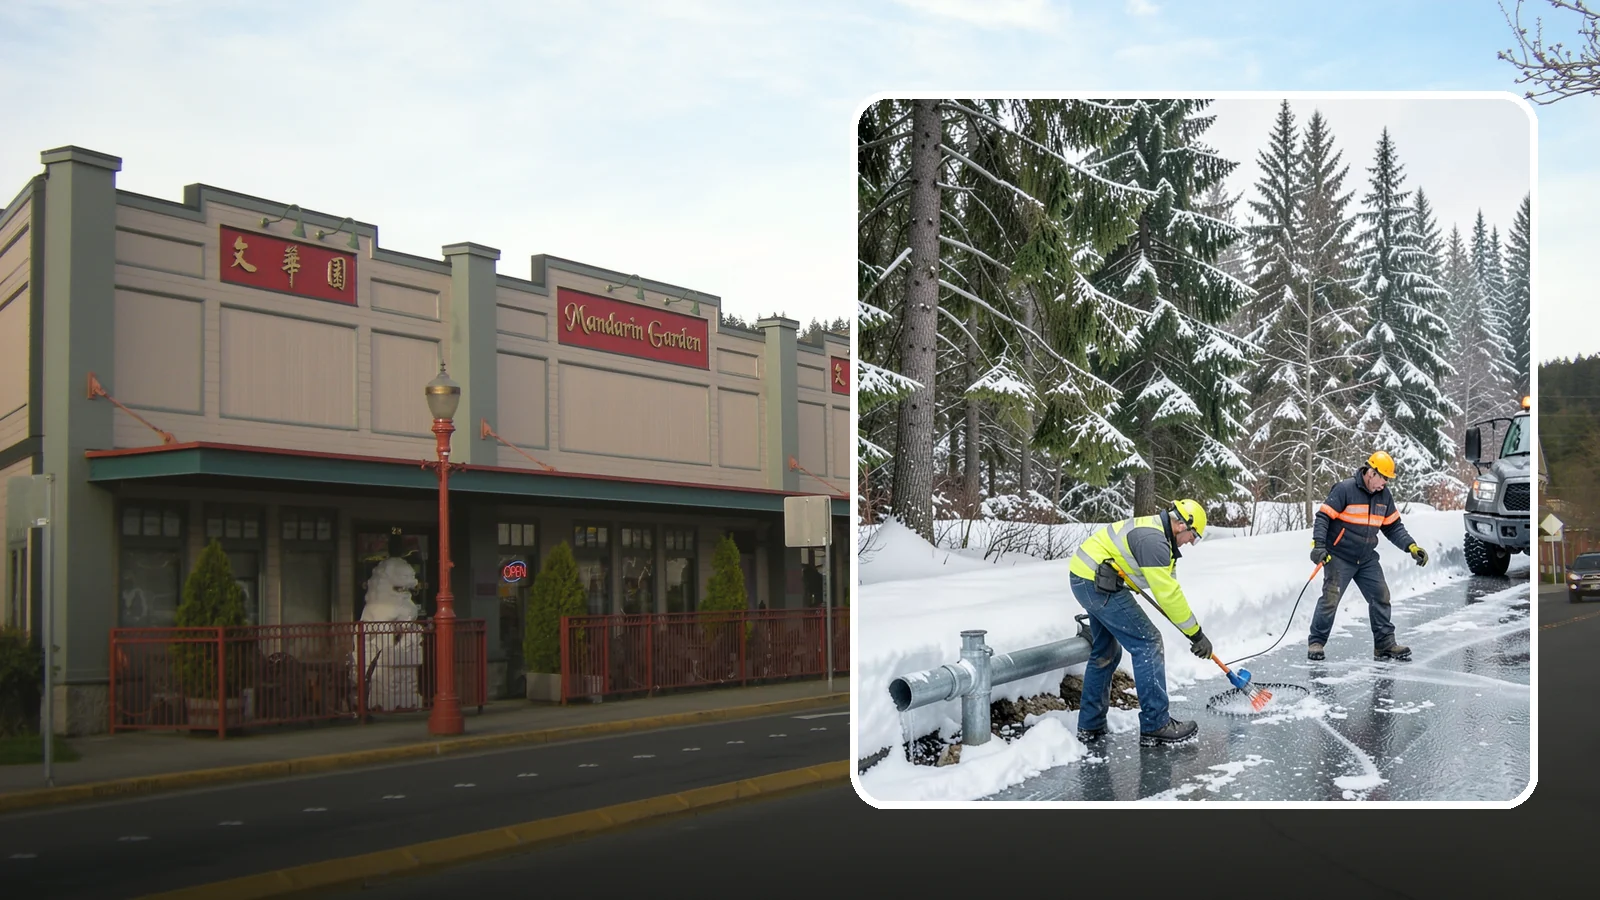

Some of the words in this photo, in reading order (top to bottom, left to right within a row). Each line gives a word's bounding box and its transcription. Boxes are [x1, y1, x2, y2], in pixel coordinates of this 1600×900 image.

[231, 236, 346, 291] 文華園
[564, 302, 644, 341] Mandarin
[648, 320, 701, 352] Garden
[503, 565, 526, 578] OPEN
